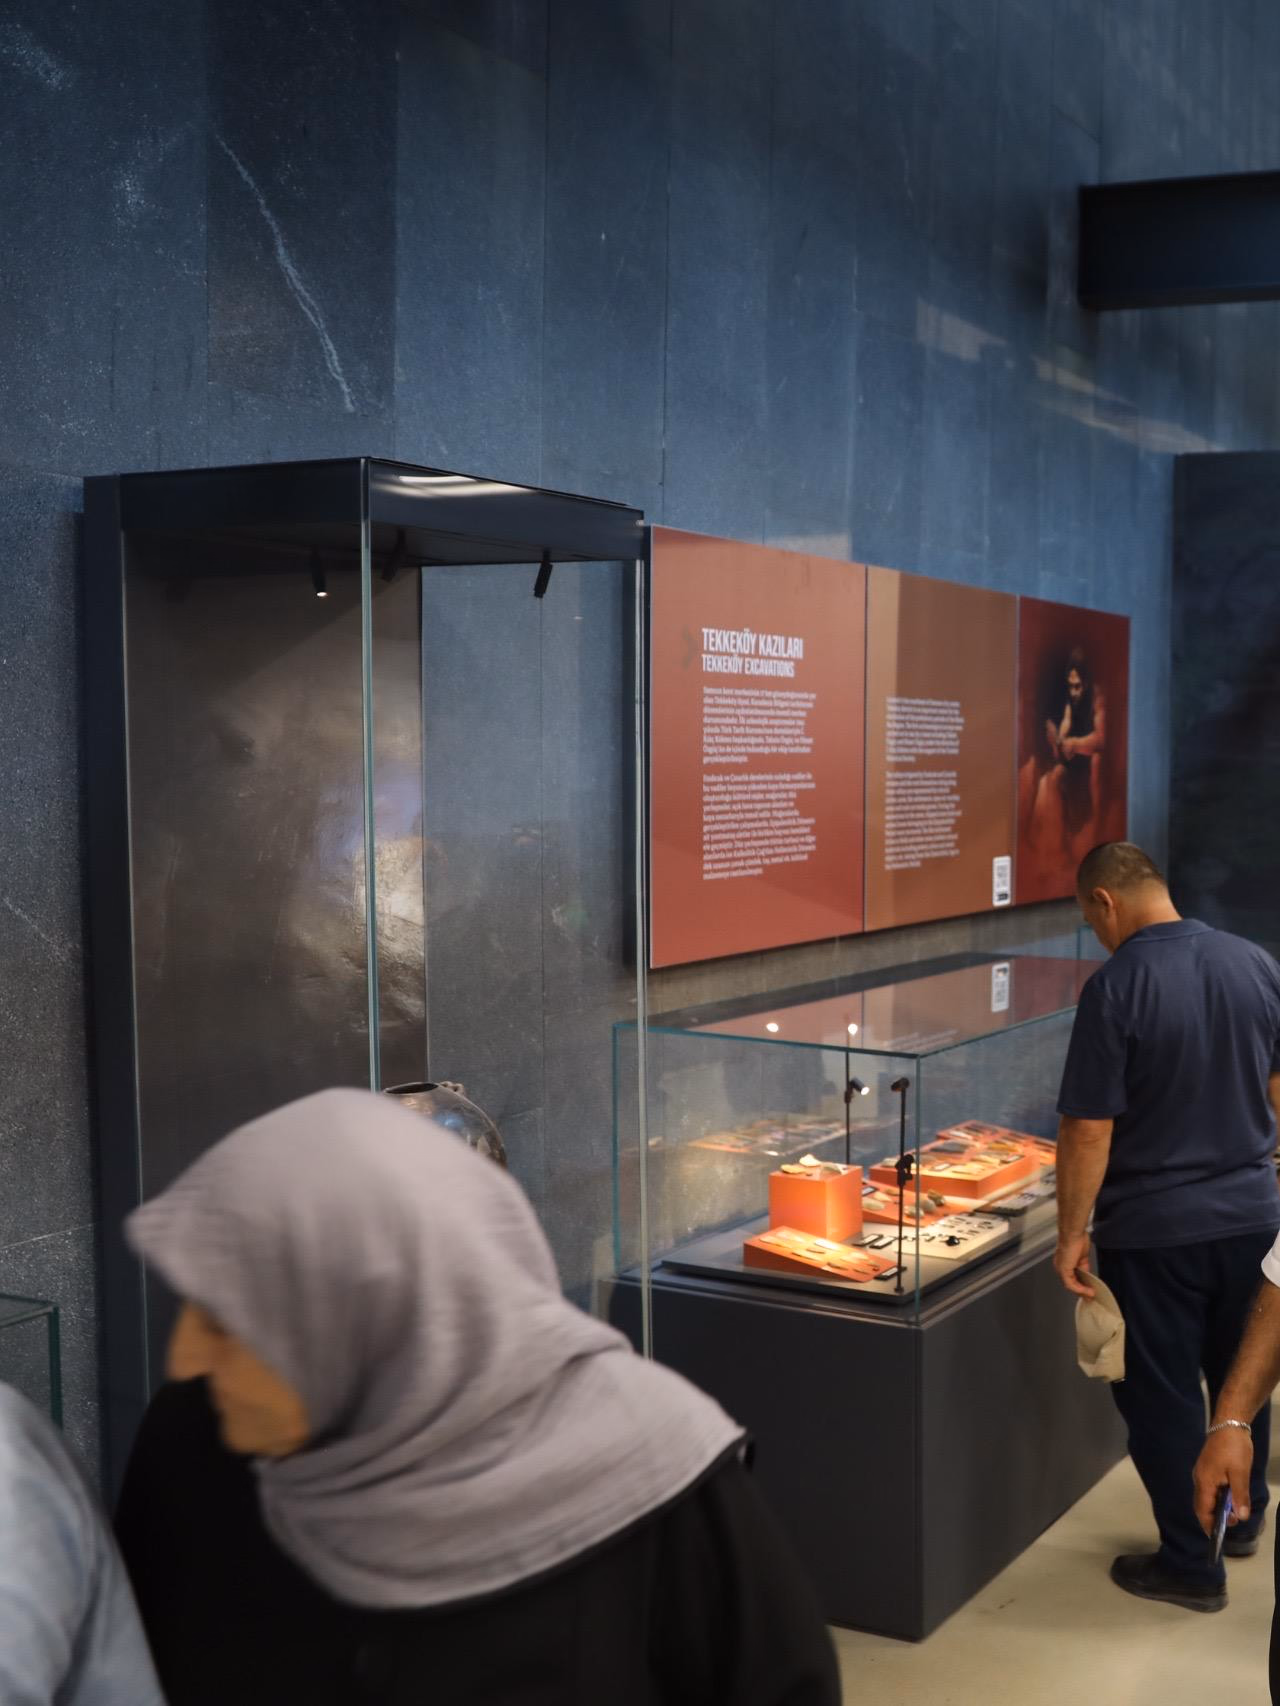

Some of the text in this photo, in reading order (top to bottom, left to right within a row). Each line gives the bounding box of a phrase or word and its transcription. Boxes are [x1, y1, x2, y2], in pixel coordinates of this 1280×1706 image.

[702, 628, 804, 660] TEKKEKÖY KAZILARI
[702, 654, 795, 678] TEKKEKÖY EXCAVATIONS
